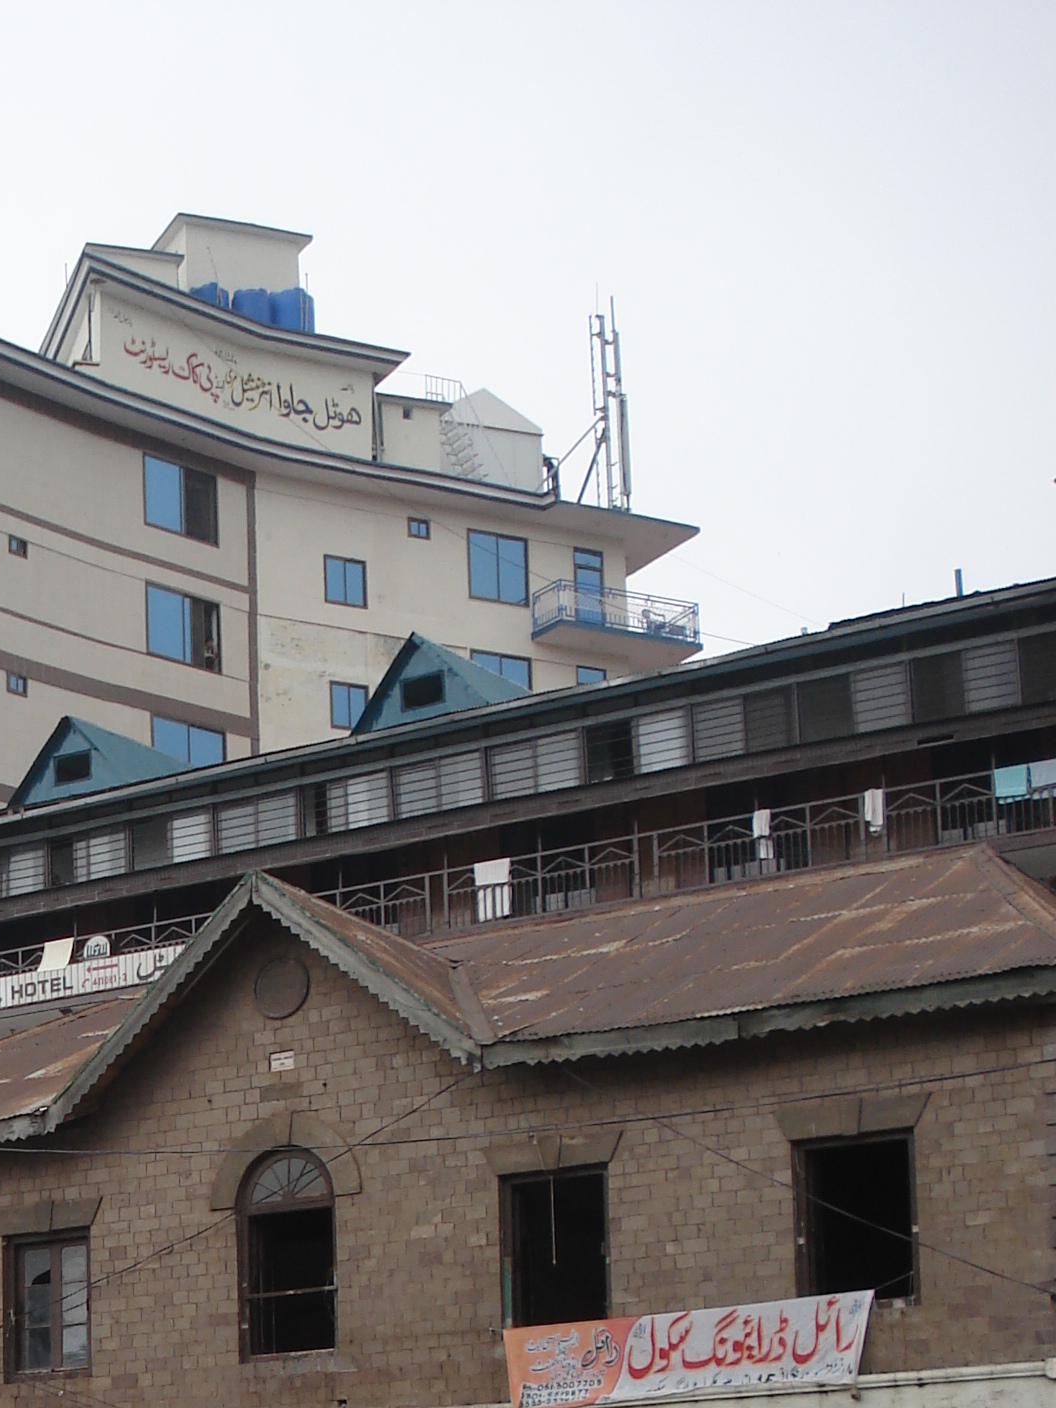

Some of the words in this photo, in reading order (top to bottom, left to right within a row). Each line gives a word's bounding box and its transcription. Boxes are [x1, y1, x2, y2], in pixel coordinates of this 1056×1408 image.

[11, 976, 73, 1001] HOTEL
[627, 1311, 694, 1380] سکول
[793, 1295, 859, 1364] رائل
